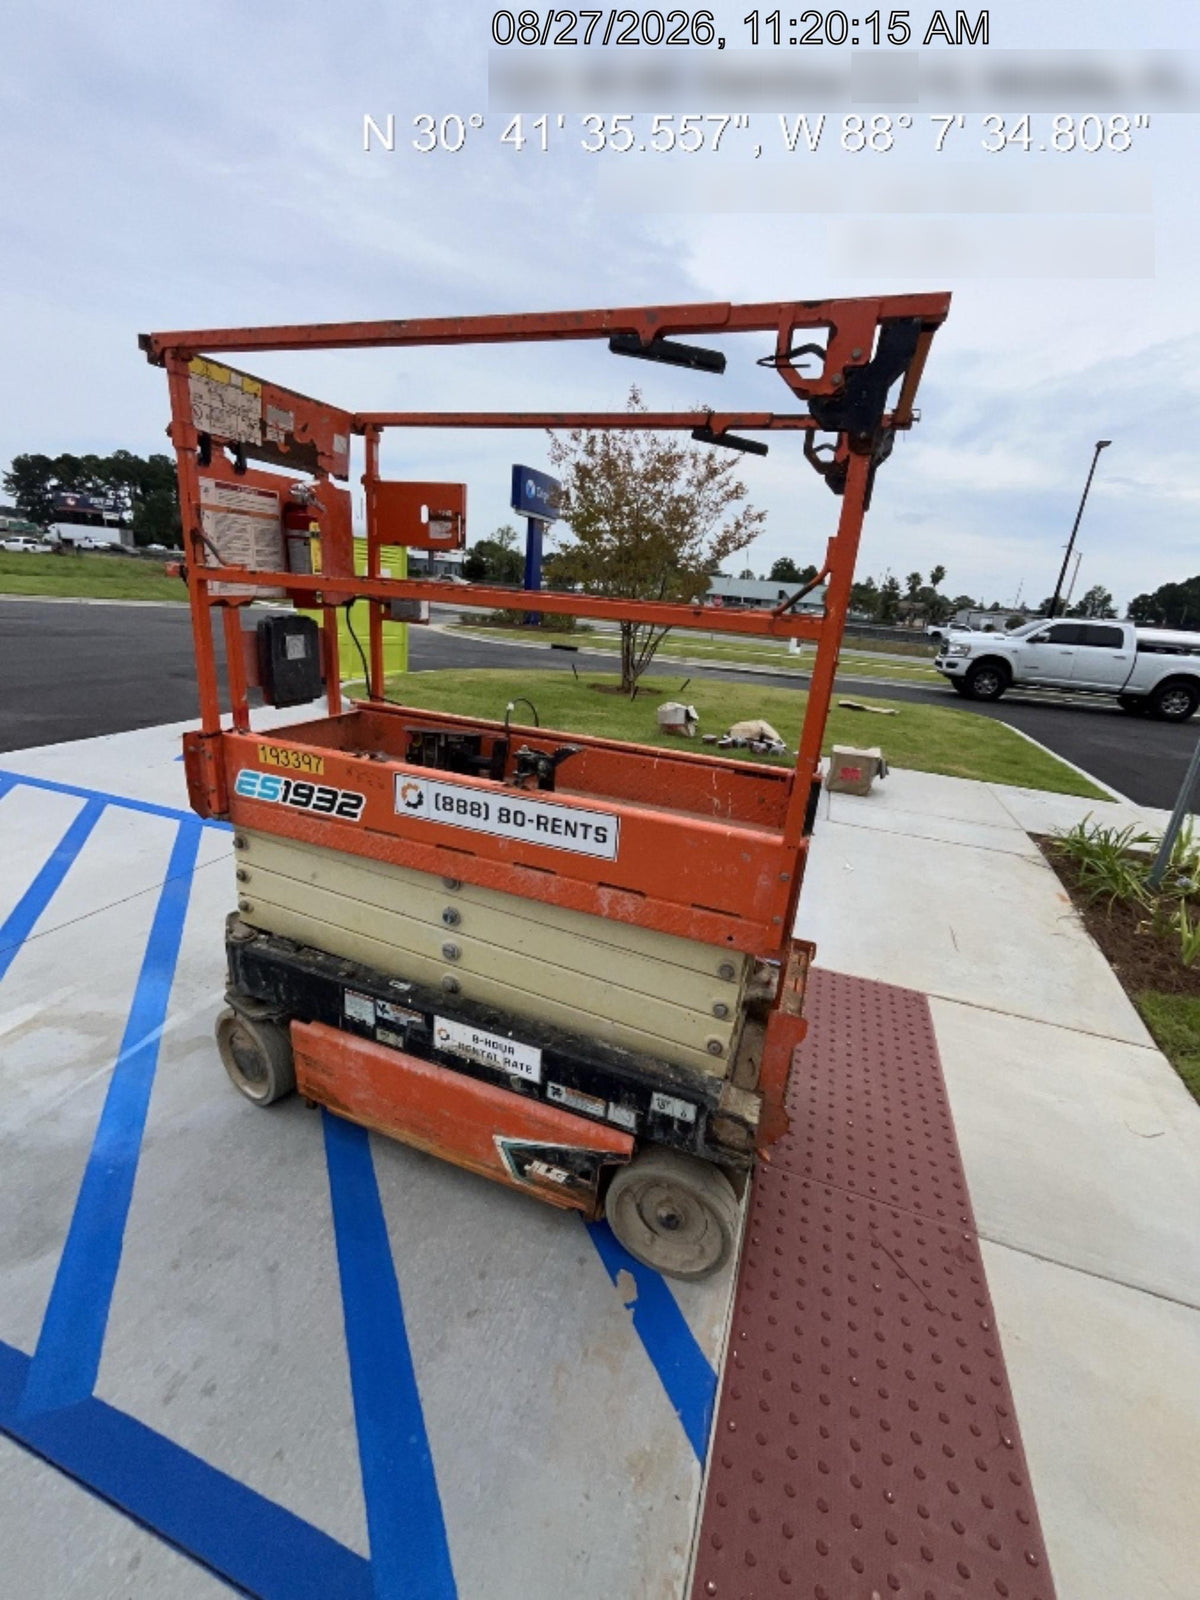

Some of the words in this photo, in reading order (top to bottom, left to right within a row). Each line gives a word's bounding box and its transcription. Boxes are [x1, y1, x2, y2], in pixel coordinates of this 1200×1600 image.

[259, 746, 322, 772] 193397
[236, 770, 364, 819] ES1932
[435, 792, 490, 821] (888)
[497, 806, 609, 844] 80-RENTS
[503, 1057, 533, 1075] RATE
